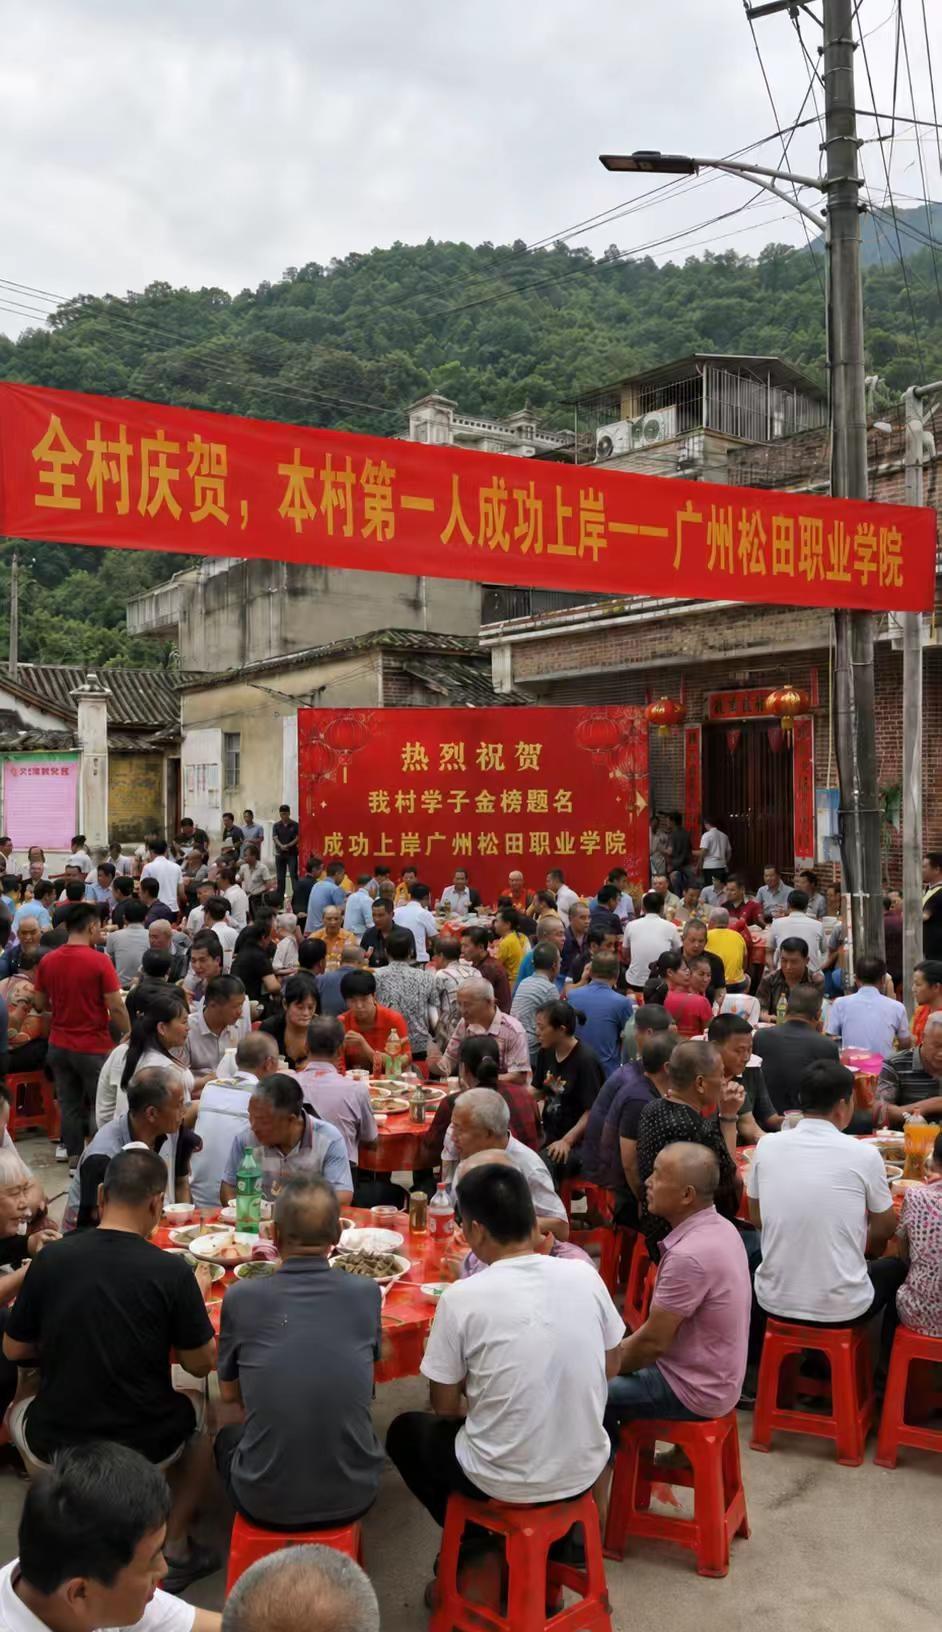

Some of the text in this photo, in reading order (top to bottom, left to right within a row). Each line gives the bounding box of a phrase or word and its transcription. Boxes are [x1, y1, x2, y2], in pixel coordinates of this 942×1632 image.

[400, 740, 544, 772] 热烈祝贺
[368, 788, 574, 815] 我村学子金榜题名
[322, 829, 628, 857] 成功上岸广州松田职业学院
